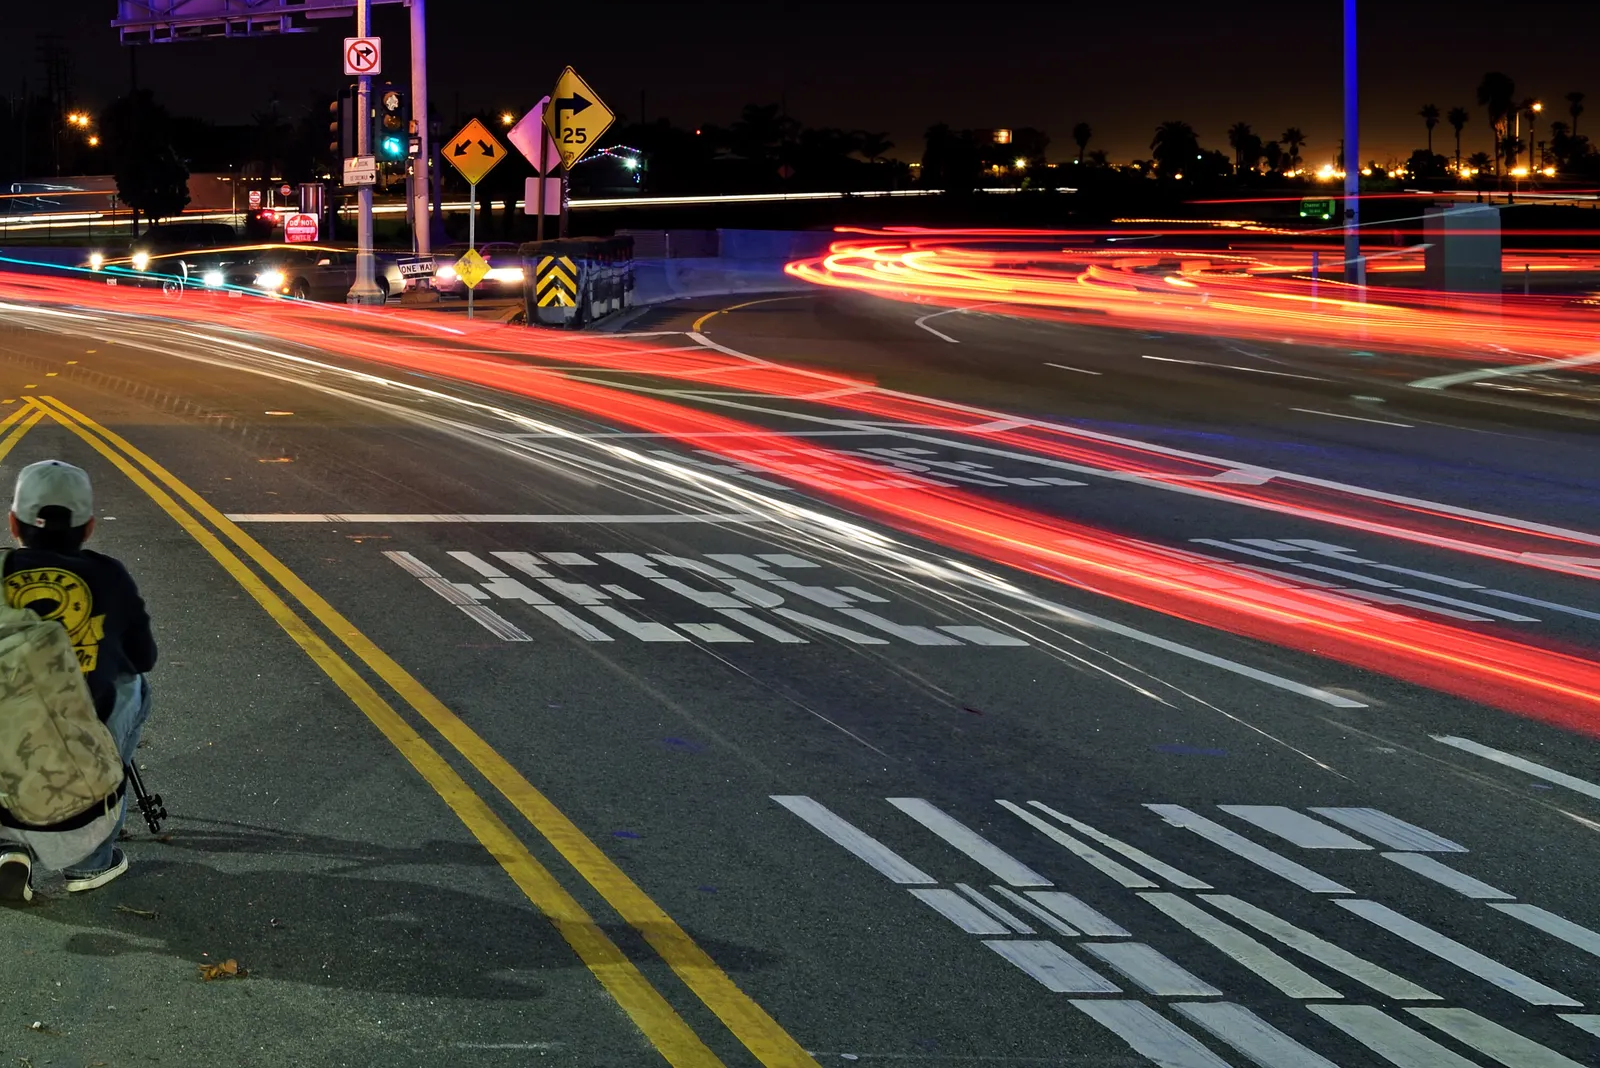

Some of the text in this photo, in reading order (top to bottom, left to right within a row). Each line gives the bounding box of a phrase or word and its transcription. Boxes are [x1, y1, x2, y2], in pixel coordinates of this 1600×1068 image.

[563, 127, 587, 144] 25
[401, 263, 433, 274] ONE WAY
[381, 551, 1030, 646] HERE
